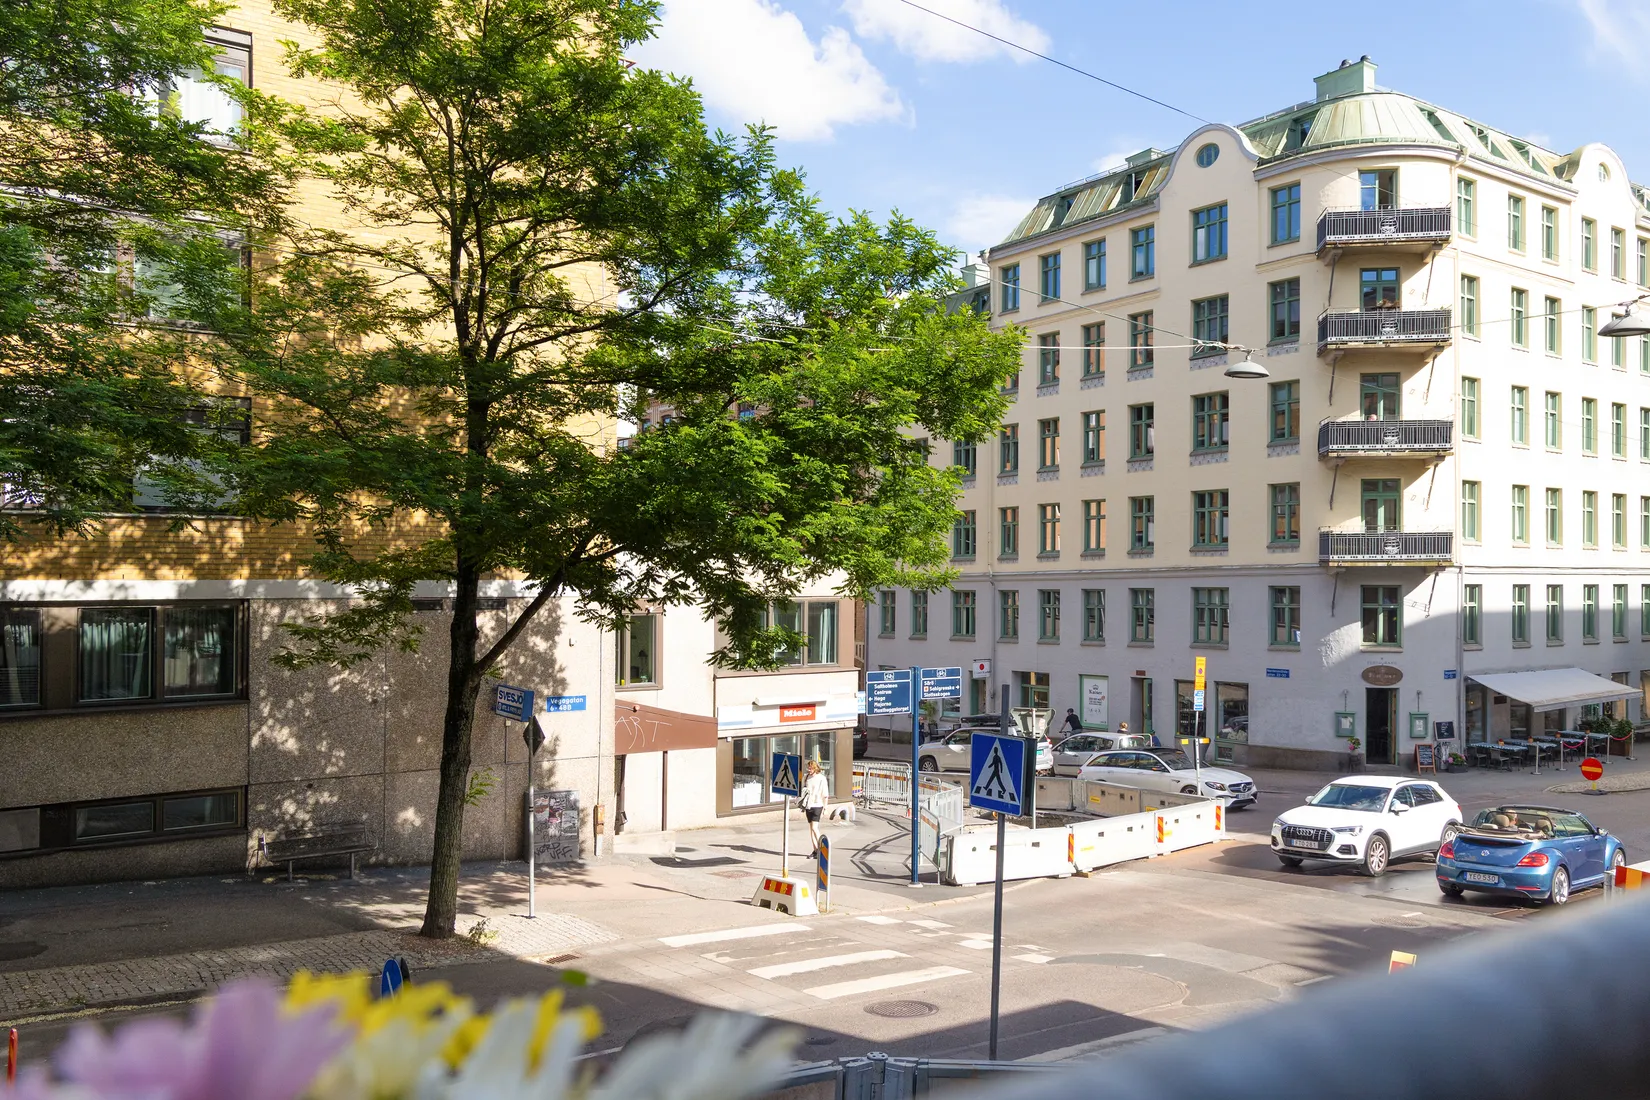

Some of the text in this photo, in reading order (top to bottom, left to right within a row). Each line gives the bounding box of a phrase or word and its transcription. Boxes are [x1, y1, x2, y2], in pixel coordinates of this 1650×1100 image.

[498, 690, 524, 705] SVESJÖ
[550, 697, 584, 705] Vegagatan
[783, 709, 813, 718] Miele
[1482, 874, 1496, 882] 530
